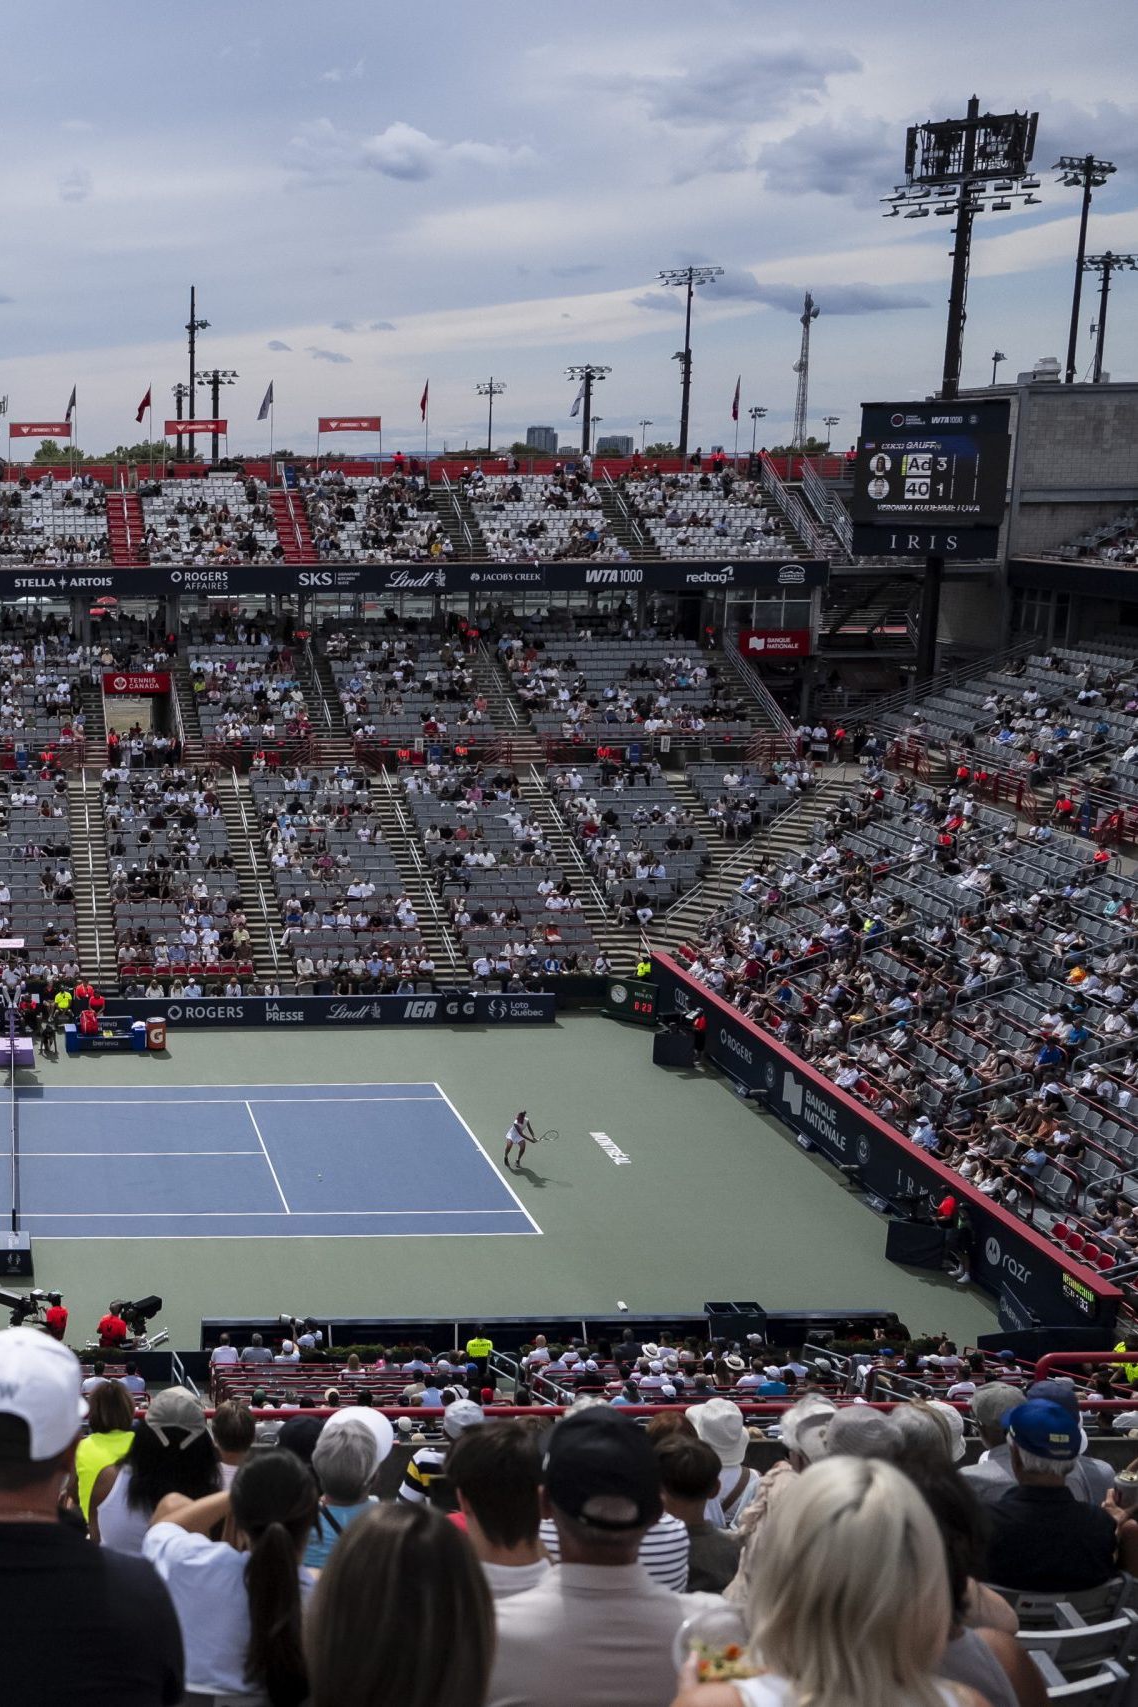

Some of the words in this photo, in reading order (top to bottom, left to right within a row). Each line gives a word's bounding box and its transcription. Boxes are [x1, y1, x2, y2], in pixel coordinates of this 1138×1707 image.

[909, 458, 932, 471] Ad
[937, 457, 948, 471] 3
[905, 482, 930, 496] 40
[936, 483, 944, 496] 1
[890, 535, 958, 550] IRIS
[14, 578, 56, 588] STELLA
[69, 577, 112, 587] ARTOIS
[184, 572, 228, 581] ROGERS
[298, 572, 333, 586] SKS
[386, 570, 435, 588] Lindt
[585, 568, 619, 583] WTA
[619, 568, 642, 583] 1000
[184, 581, 228, 590] AFFAIRES
[185, 1005, 244, 1018] ROGERS
[266, 1002, 280, 1011] LA
[326, 1003, 371, 1019] Lindt
[403, 1001, 437, 1018] IGA
[510, 1009, 543, 1017] Québec
[266, 1011, 304, 1021] PRESSE
[727, 1035, 752, 1064] ROGERS
[805, 1090, 837, 1125] BANQUE
[804, 1107, 847, 1152] NATIONALE
[1002, 1255, 1032, 1284] razr
